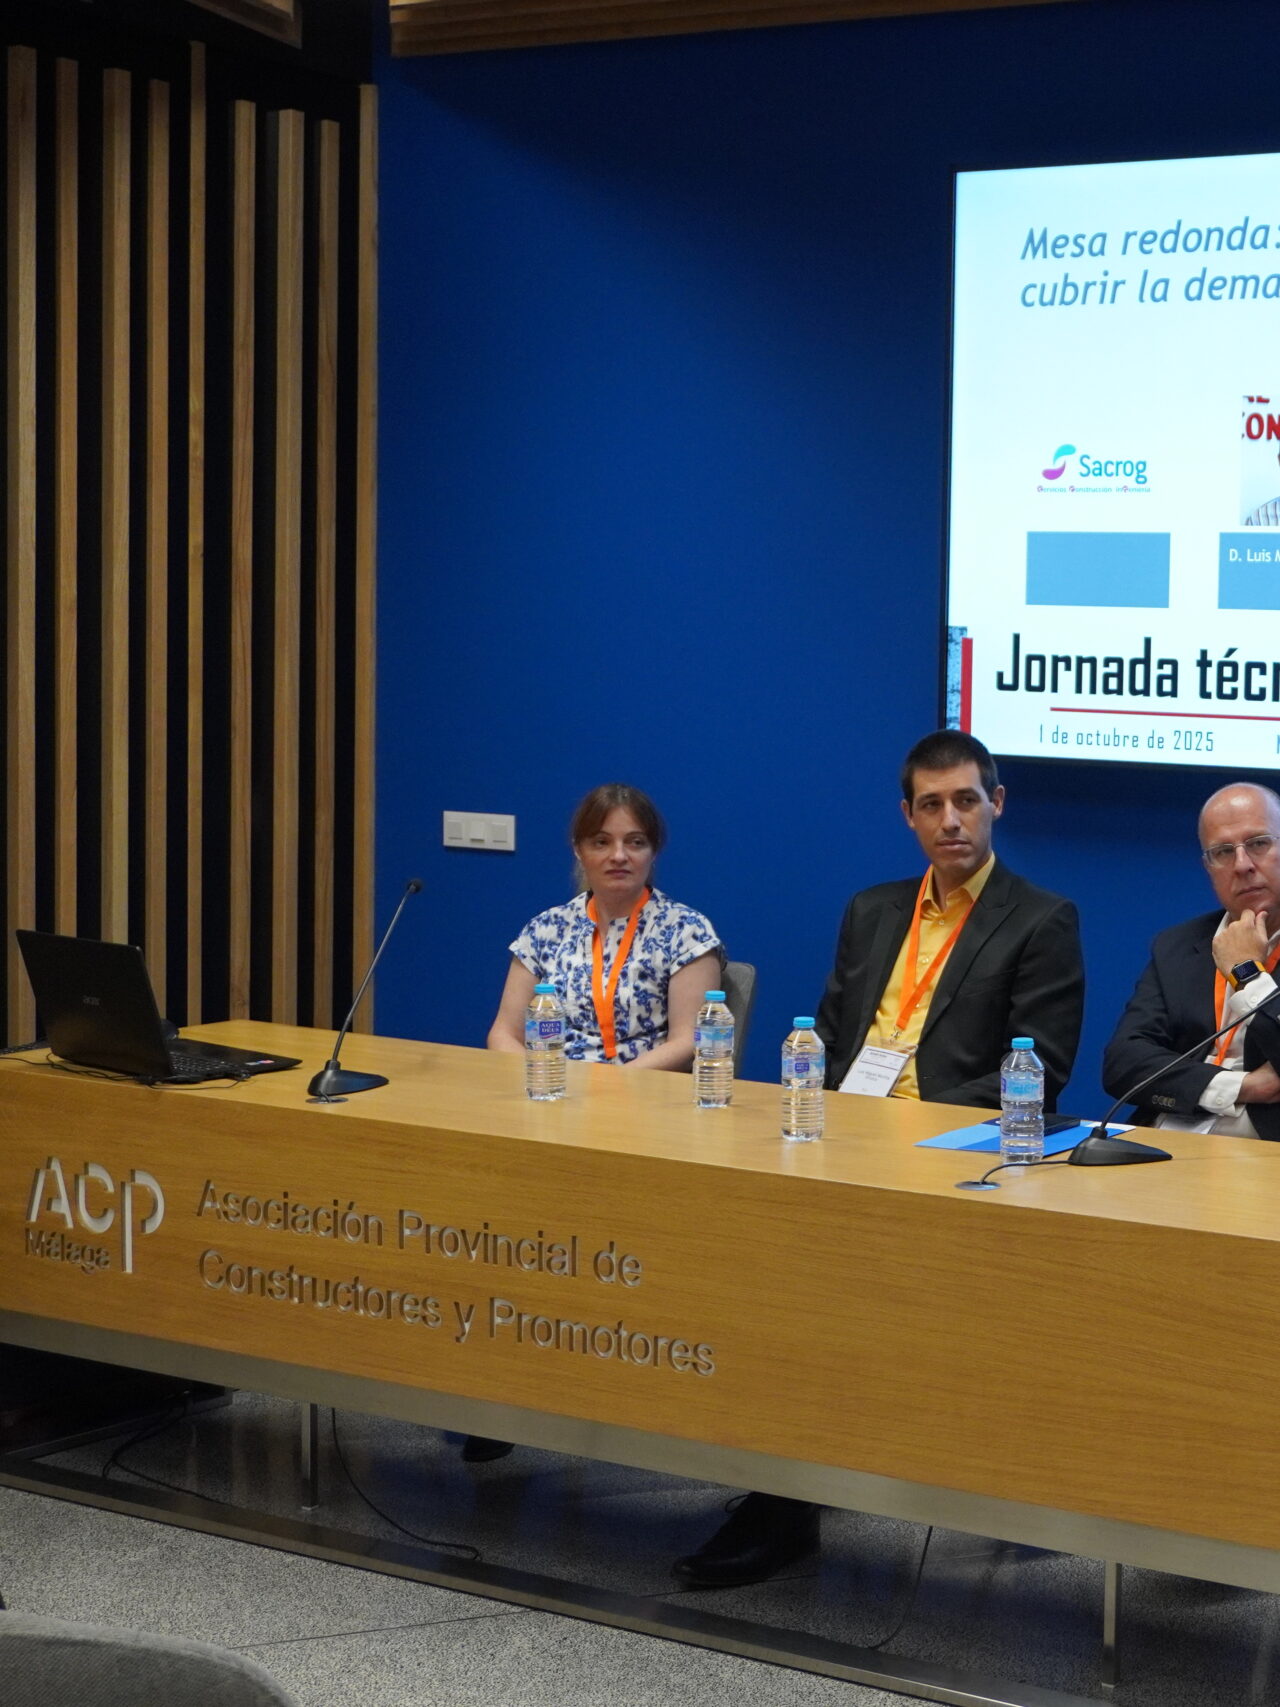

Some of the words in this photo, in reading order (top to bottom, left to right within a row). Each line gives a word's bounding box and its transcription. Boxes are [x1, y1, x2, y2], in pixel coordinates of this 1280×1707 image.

[1020, 226, 1107, 260] Mesa
[1020, 270, 1126, 308] cubrir
[1138, 269, 1170, 303] la
[1079, 454, 1148, 485] Sacrog
[1229, 549, 1242, 562] D.
[1247, 549, 1271, 562] Luis
[996, 633, 1179, 699] Jornada
[1039, 724, 1044, 744] 1
[1051, 725, 1069, 745] de
[1076, 727, 1140, 749] octubre
[1147, 729, 1166, 750] de
[1172, 730, 1215, 752] 2025
[25, 1155, 166, 1274] ACP
[196, 1179, 385, 1247] Asociación
[398, 1208, 579, 1278] Provincial
[593, 1240, 645, 1287] de
[24, 1226, 112, 1276] Málaga
[198, 1247, 442, 1330] Constructores
[453, 1300, 476, 1344] y
[488, 1295, 717, 1377] Promotores
